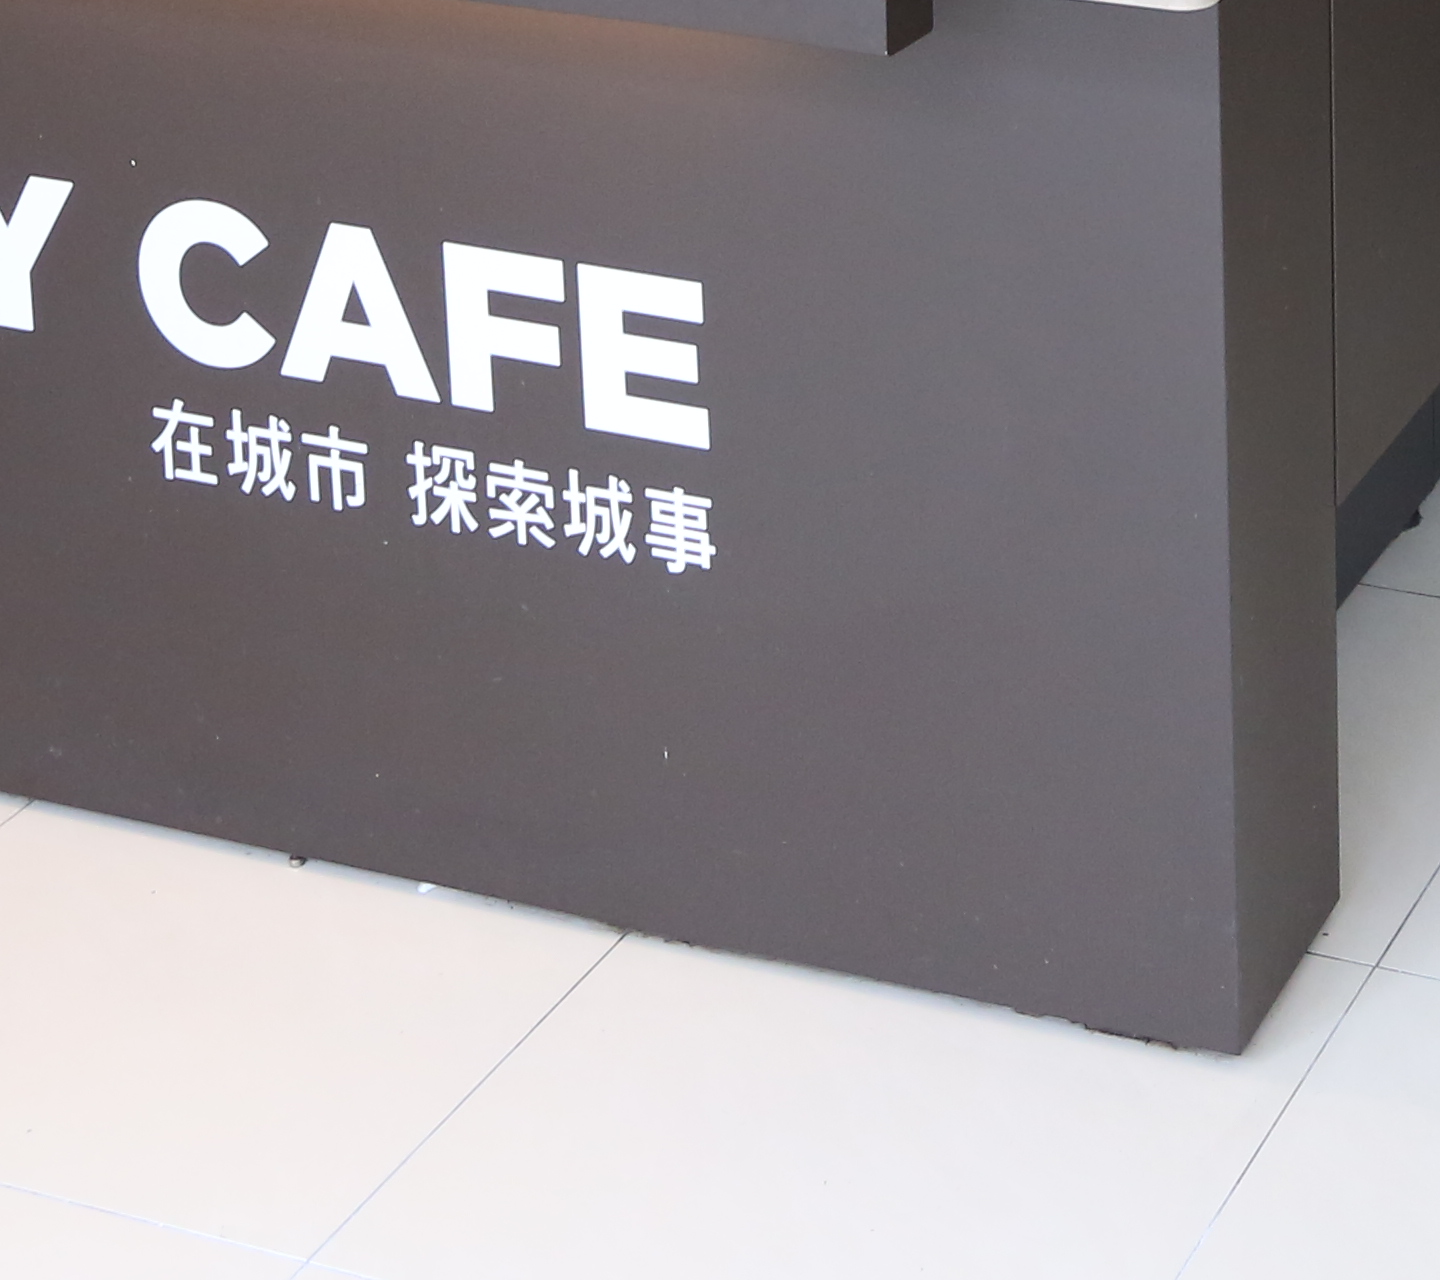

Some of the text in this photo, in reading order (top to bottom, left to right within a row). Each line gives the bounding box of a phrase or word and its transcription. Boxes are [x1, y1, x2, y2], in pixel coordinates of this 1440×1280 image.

[136, 197, 713, 452] CAFE
[148, 396, 718, 575] 在城市 探索城事
